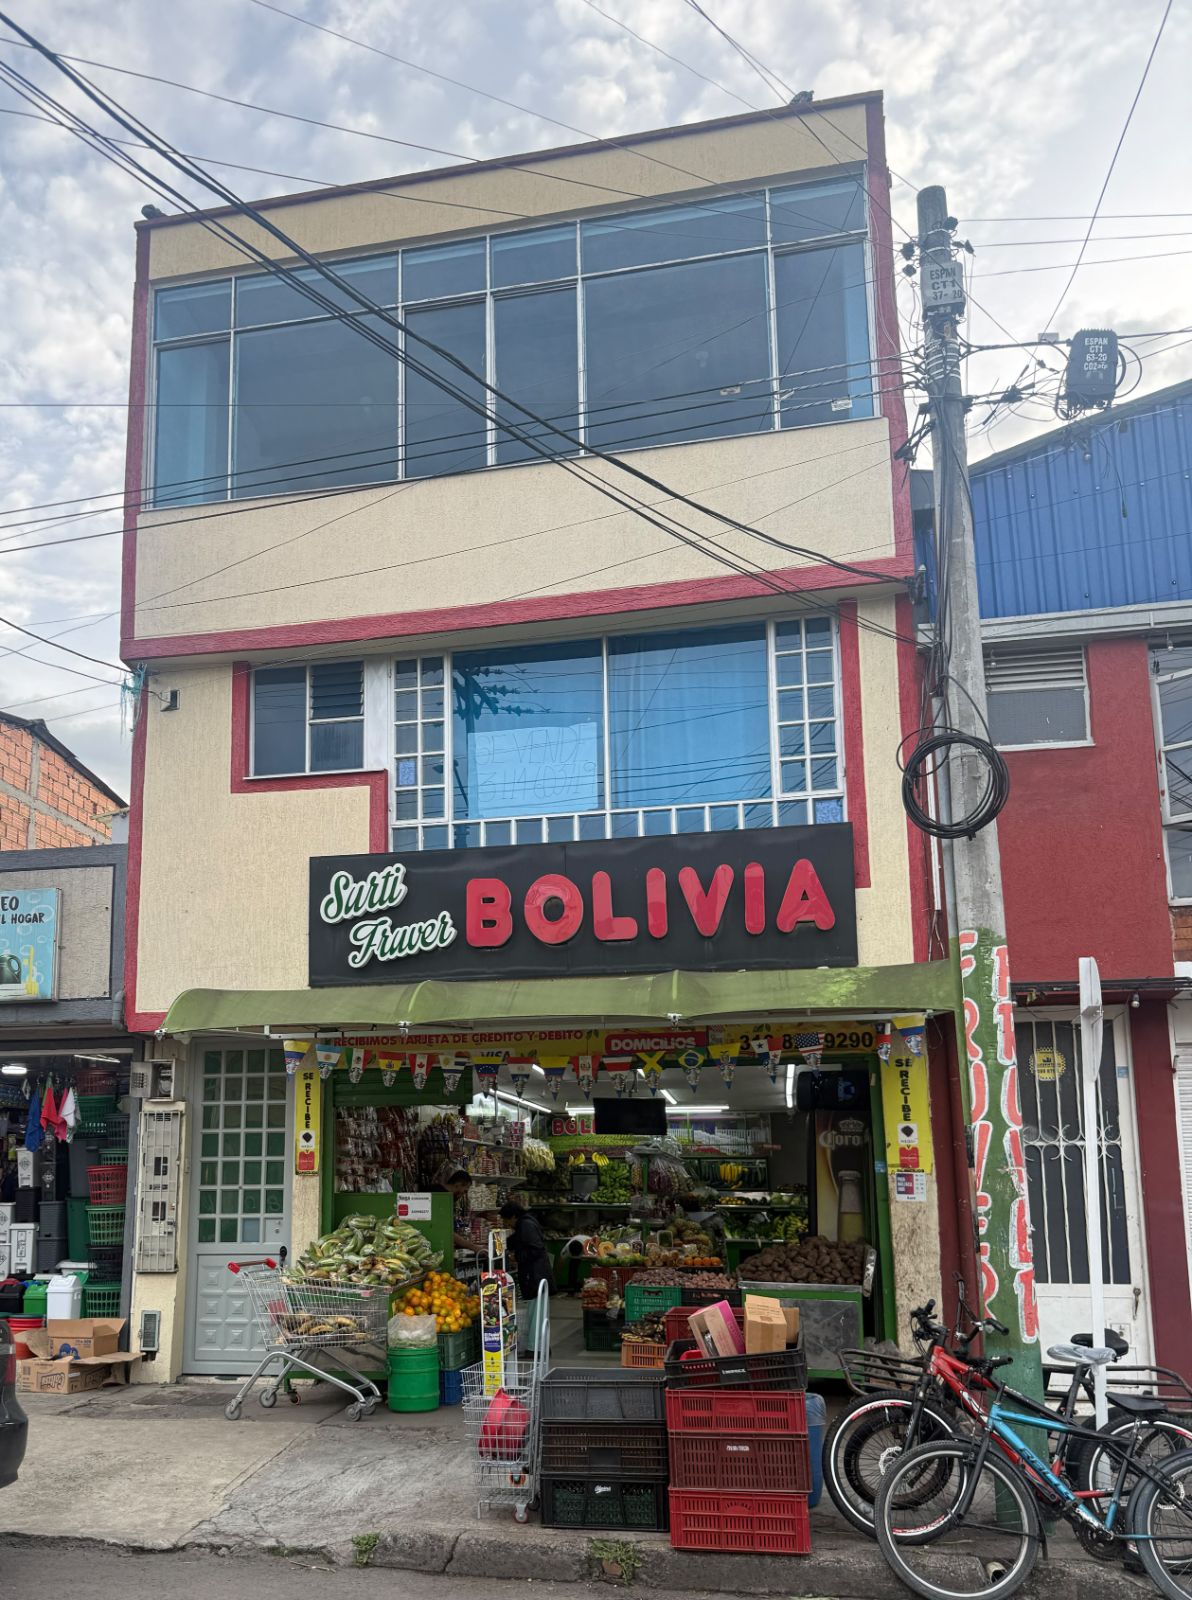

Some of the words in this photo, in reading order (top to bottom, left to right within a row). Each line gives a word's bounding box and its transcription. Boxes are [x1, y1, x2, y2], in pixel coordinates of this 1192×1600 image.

[1084, 337, 1108, 346] ESPAN
[513, 724, 589, 765] VENDE
[319, 863, 408, 924] Surti
[466, 858, 836, 948] BOLIVIA
[11, 912, 45, 924] HOGAR
[347, 910, 458, 969] Fruver
[334, 1036, 397, 1047] RECIBIMOS
[401, 1034, 449, 1045] TARJETA
[453, 1033, 469, 1044] DE
[472, 1032, 523, 1043] CREDITO
[527, 1031, 536, 1041] Y
[539, 1030, 584, 1041] DEBITO
[611, 1036, 697, 1051] DOMICILIOS
[303, 1072, 314, 1080] SE
[895, 1058, 912, 1067] SE
[304, 1083, 312, 1129] RECIBE
[899, 1070, 912, 1122] RECIBE
